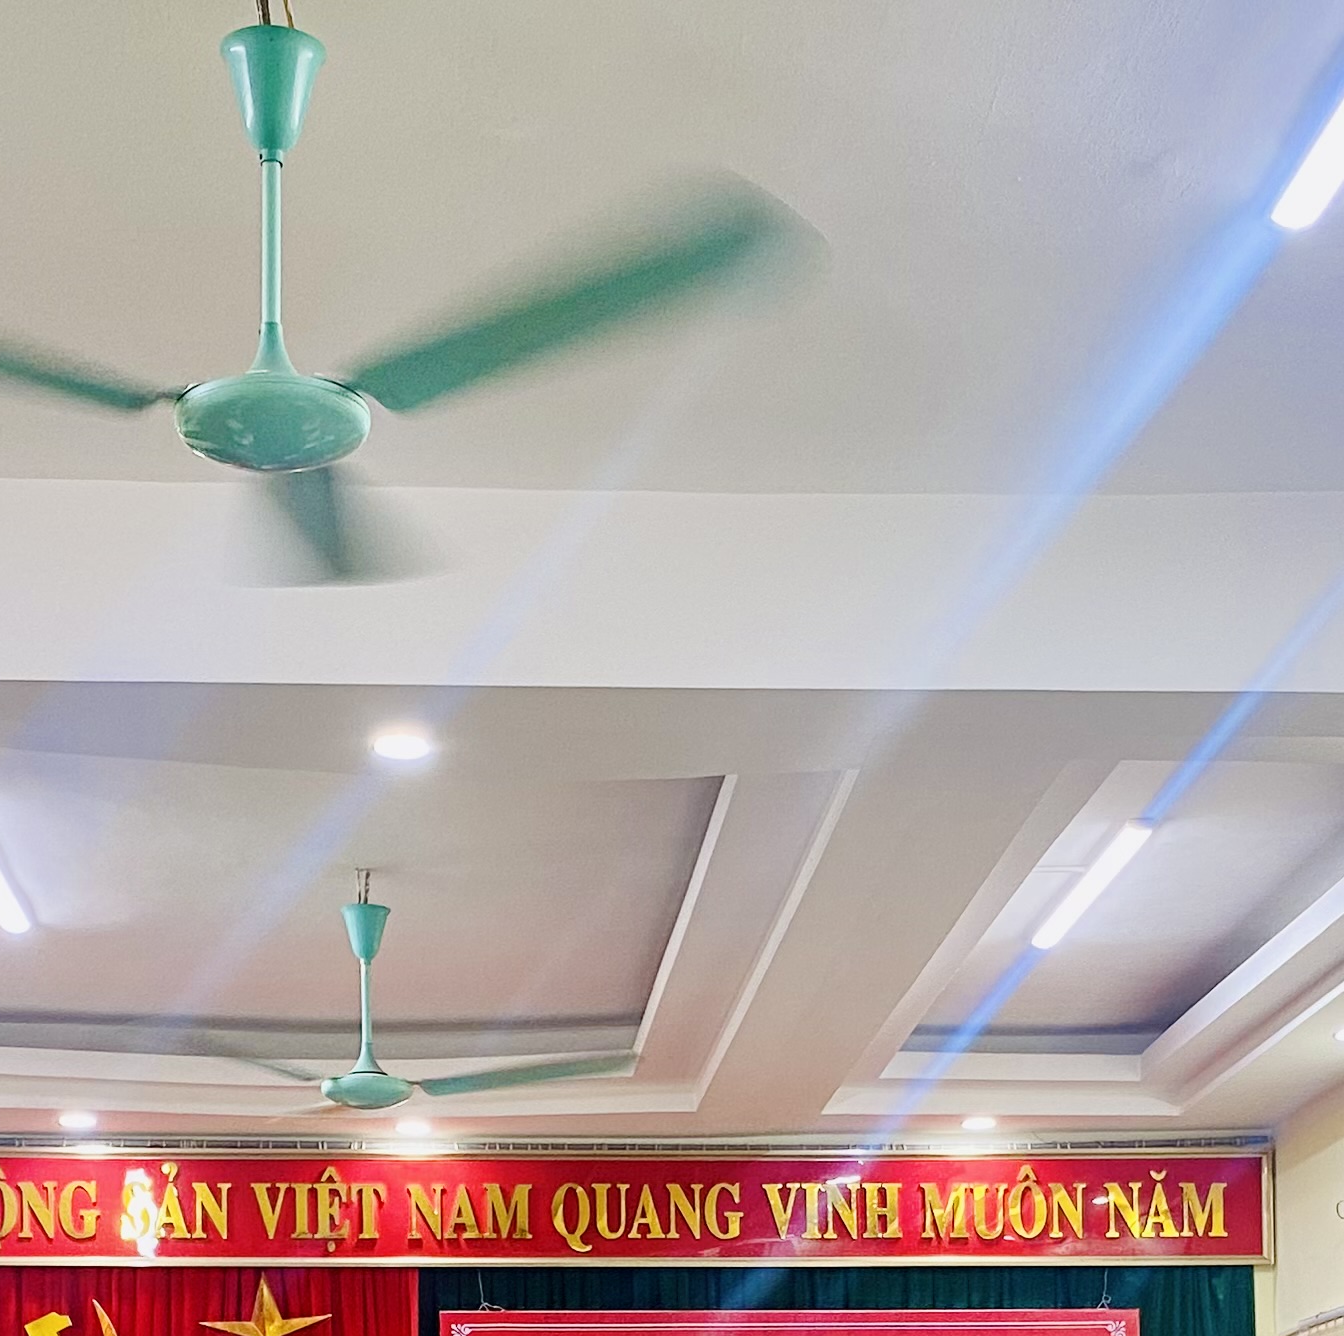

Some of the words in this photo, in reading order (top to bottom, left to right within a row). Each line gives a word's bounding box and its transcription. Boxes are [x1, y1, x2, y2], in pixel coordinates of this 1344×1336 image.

[120, 1162, 232, 1242] SẢN
[251, 1164, 386, 1252] VIỆT
[407, 1181, 533, 1241] NAM
[552, 1182, 744, 1253] QUANG
[763, 1181, 903, 1241] VINH
[920, 1165, 1086, 1241] MUÔN
[1105, 1169, 1229, 1239] NĂM
